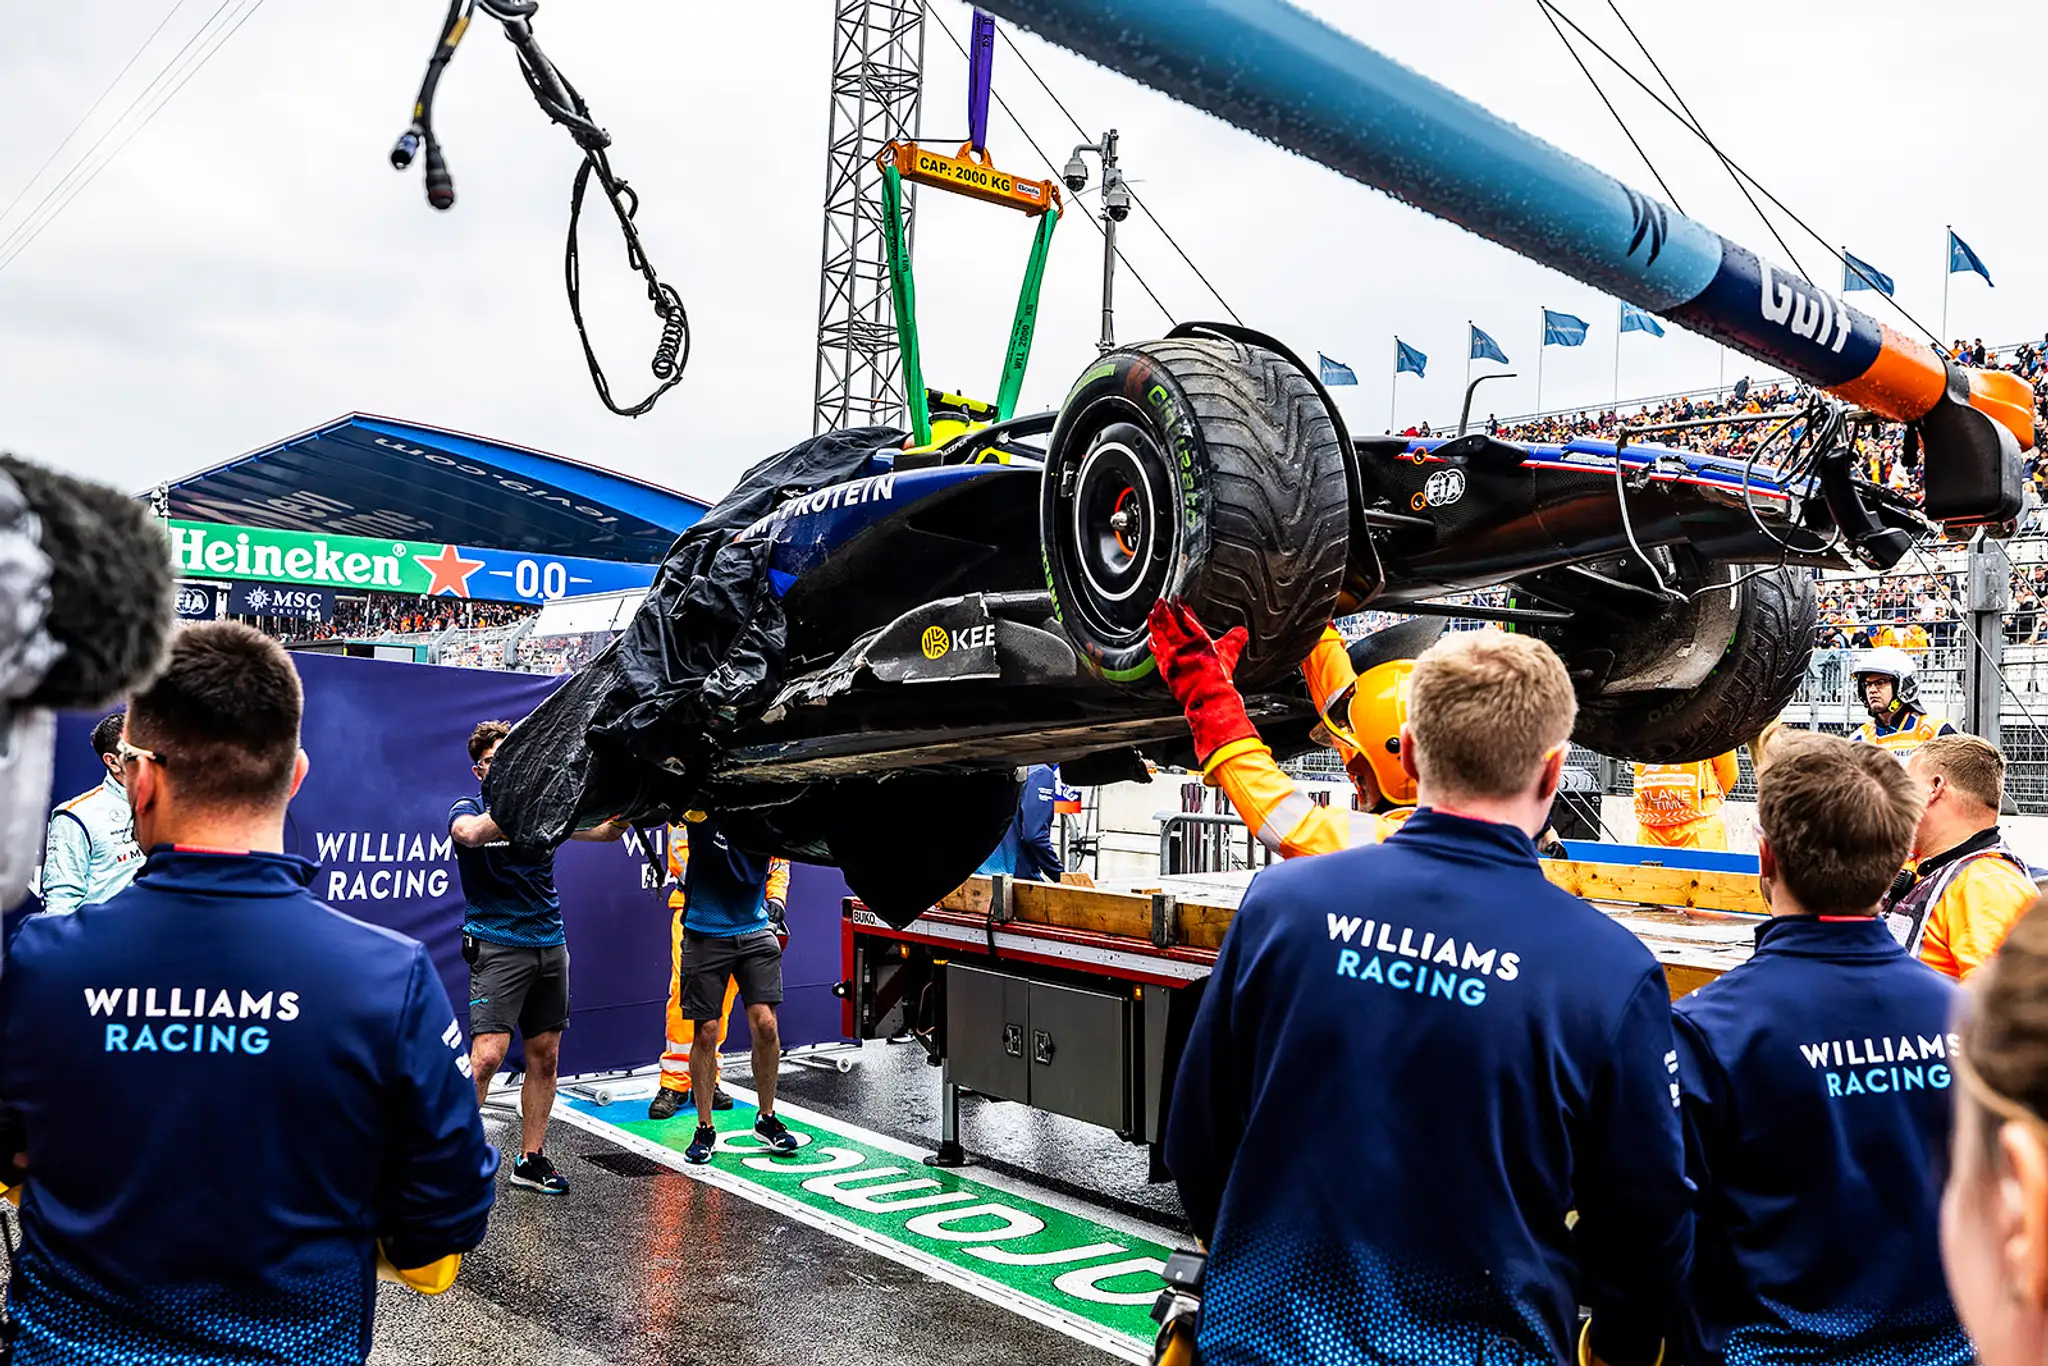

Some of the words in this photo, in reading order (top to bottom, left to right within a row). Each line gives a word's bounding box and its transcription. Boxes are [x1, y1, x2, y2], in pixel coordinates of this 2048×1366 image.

[919, 157, 951, 176] CAP:
[955, 166, 987, 186] 2000
[991, 176, 1010, 192] KG
[1759, 260, 1852, 354] Gulf
[1018, 324, 1030, 347] 2000
[374, 437, 620, 524] levi9.com
[1427, 473, 1462, 502] FIA
[751, 474, 897, 537] MPROTEIN
[169, 527, 403, 587] Heineken
[515, 558, 567, 601] 0.0
[272, 590, 322, 609] MSC
[315, 831, 453, 863] WILLIAM
[327, 869, 449, 901] RACING
[1326, 913, 1521, 982] WILLIAMS
[1337, 948, 1486, 1006] RACING
[84, 987, 300, 1023] WILLIAMS
[105, 1023, 271, 1055] RACING
[1800, 1031, 1961, 1070] WILLIAMS
[1826, 1063, 1953, 1097] RACING
